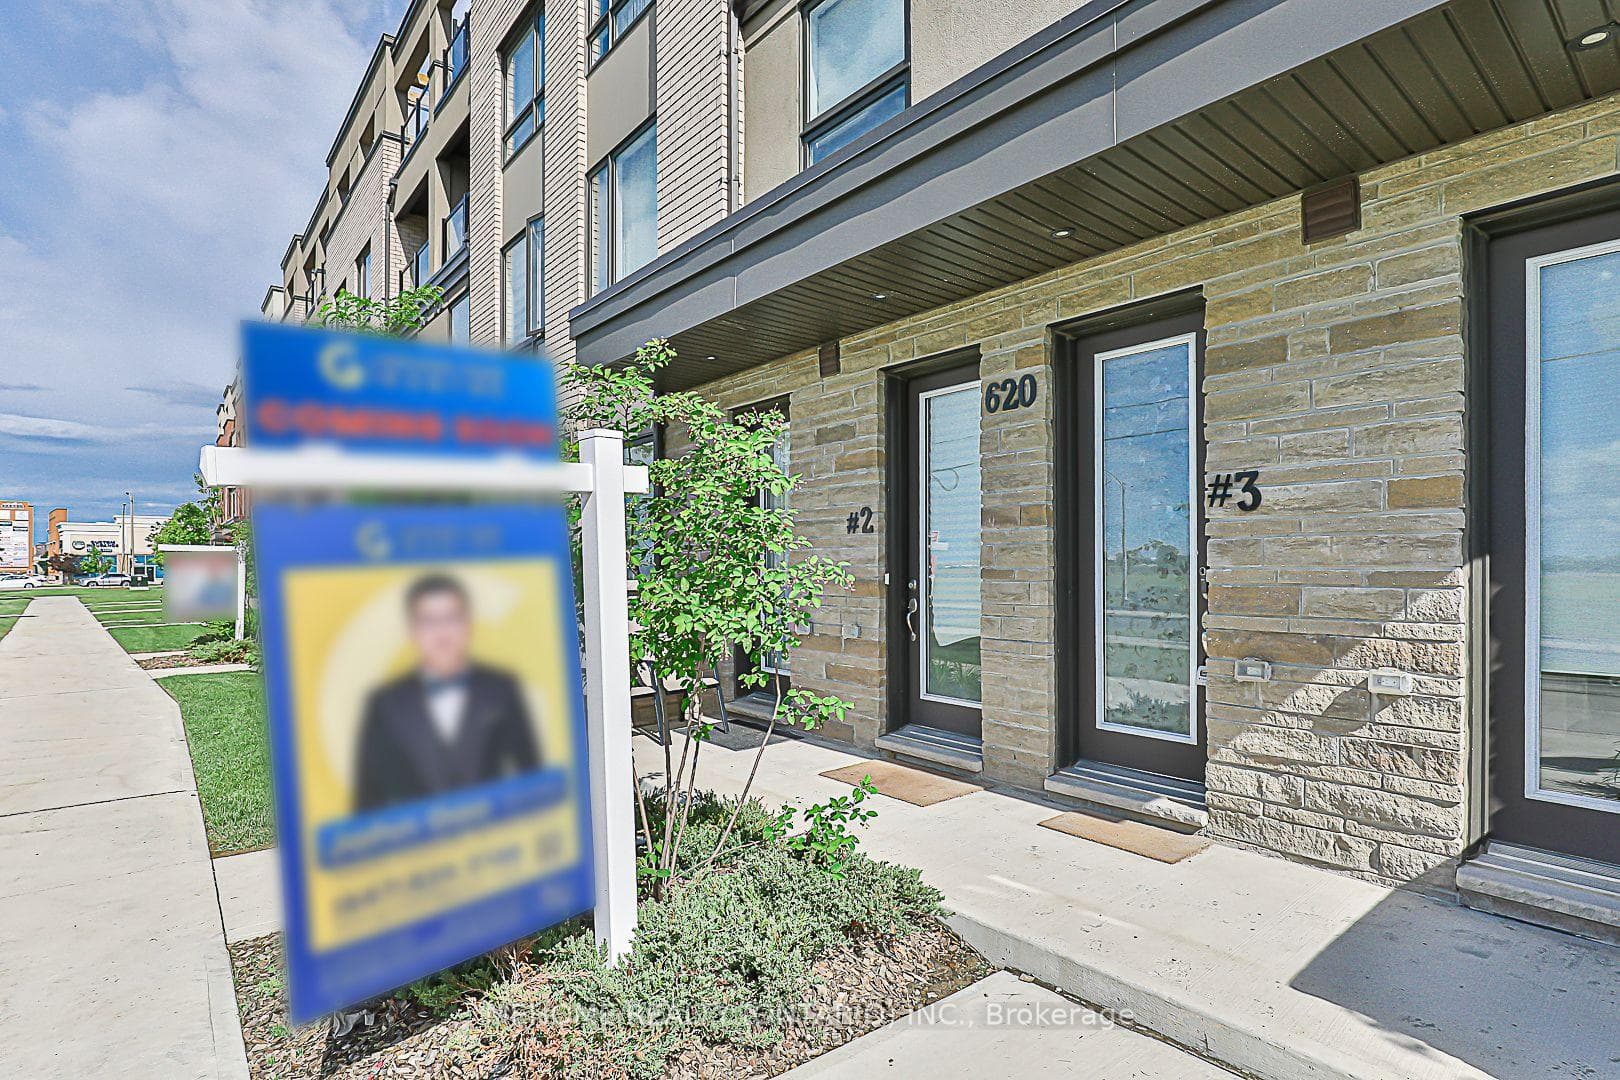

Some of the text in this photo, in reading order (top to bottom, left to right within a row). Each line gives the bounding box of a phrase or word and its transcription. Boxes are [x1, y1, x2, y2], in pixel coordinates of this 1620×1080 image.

[985, 373, 1036, 413] 620
[1207, 470, 1262, 511] #3
[846, 506, 874, 534] #2
